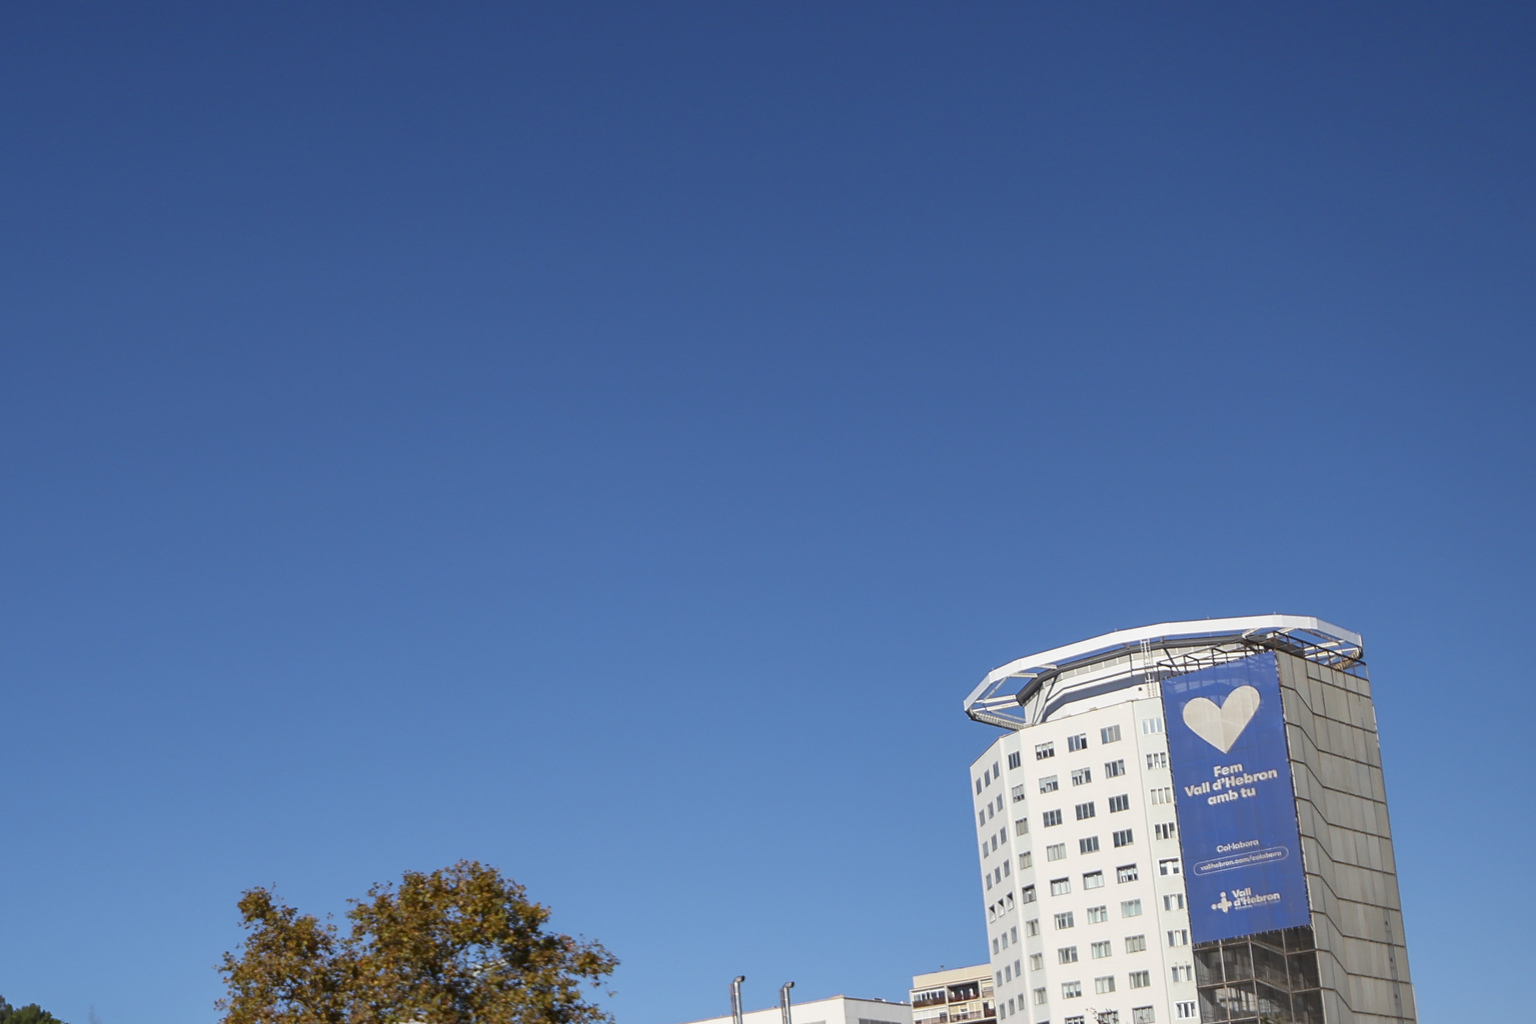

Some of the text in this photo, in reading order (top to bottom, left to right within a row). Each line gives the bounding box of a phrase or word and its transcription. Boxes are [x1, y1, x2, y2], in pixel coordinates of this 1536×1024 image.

[1213, 763, 1243, 777] Fem
[1184, 781, 1210, 797] Vall
[1207, 787, 1256, 805] amb tu
[1232, 887, 1252, 898] Vall
